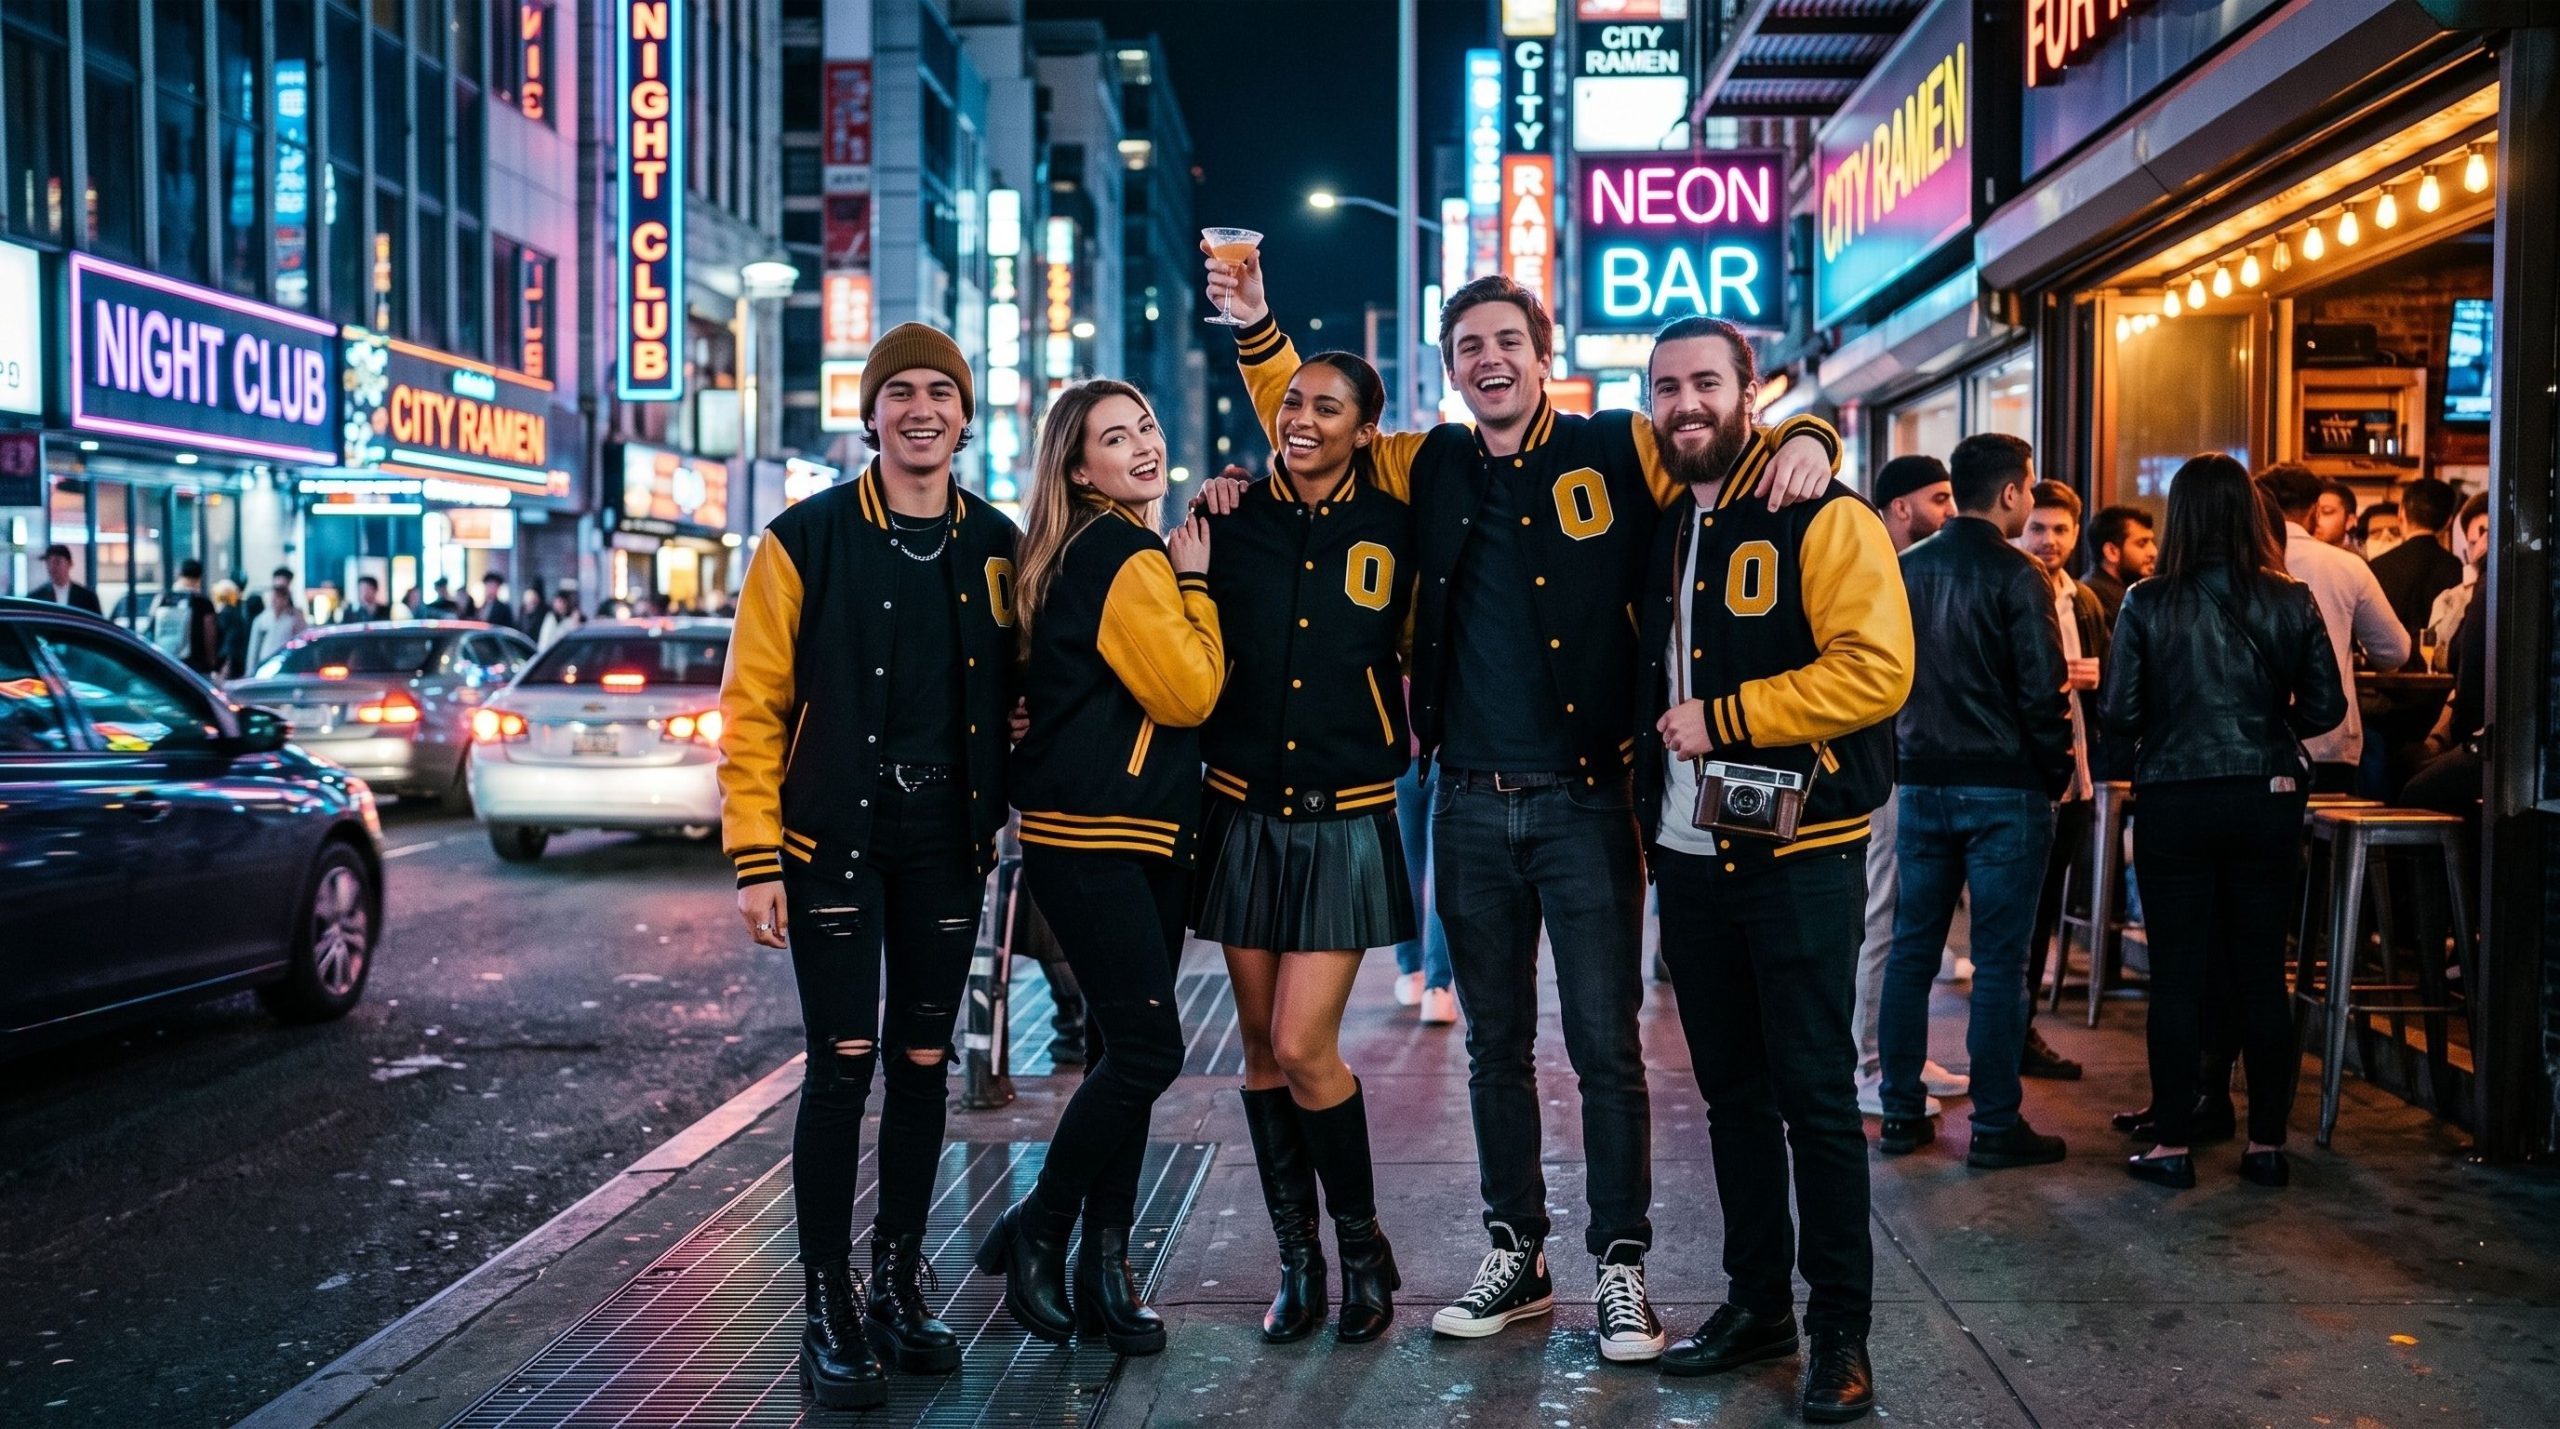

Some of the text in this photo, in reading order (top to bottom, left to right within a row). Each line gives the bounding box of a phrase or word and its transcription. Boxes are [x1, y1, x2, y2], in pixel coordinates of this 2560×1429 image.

[1585, 49, 1680, 74] RAMEN
[1601, 25, 1664, 50] CITY
[631, 2, 669, 380] NIGHT CLUB
[1509, 41, 1547, 302] CITY RAME
[1822, 42, 1965, 264] CITY RAMEN
[1591, 167, 1770, 225] NEON
[1602, 246, 1761, 318] BAR
[96, 298, 327, 427] NIGHT CLUB
[390, 383, 456, 450] CITY
[458, 399, 546, 466] RAMEN
[1552, 466, 1614, 541] O
[1344, 540, 1395, 611] O
[1724, 540, 1779, 617] O
